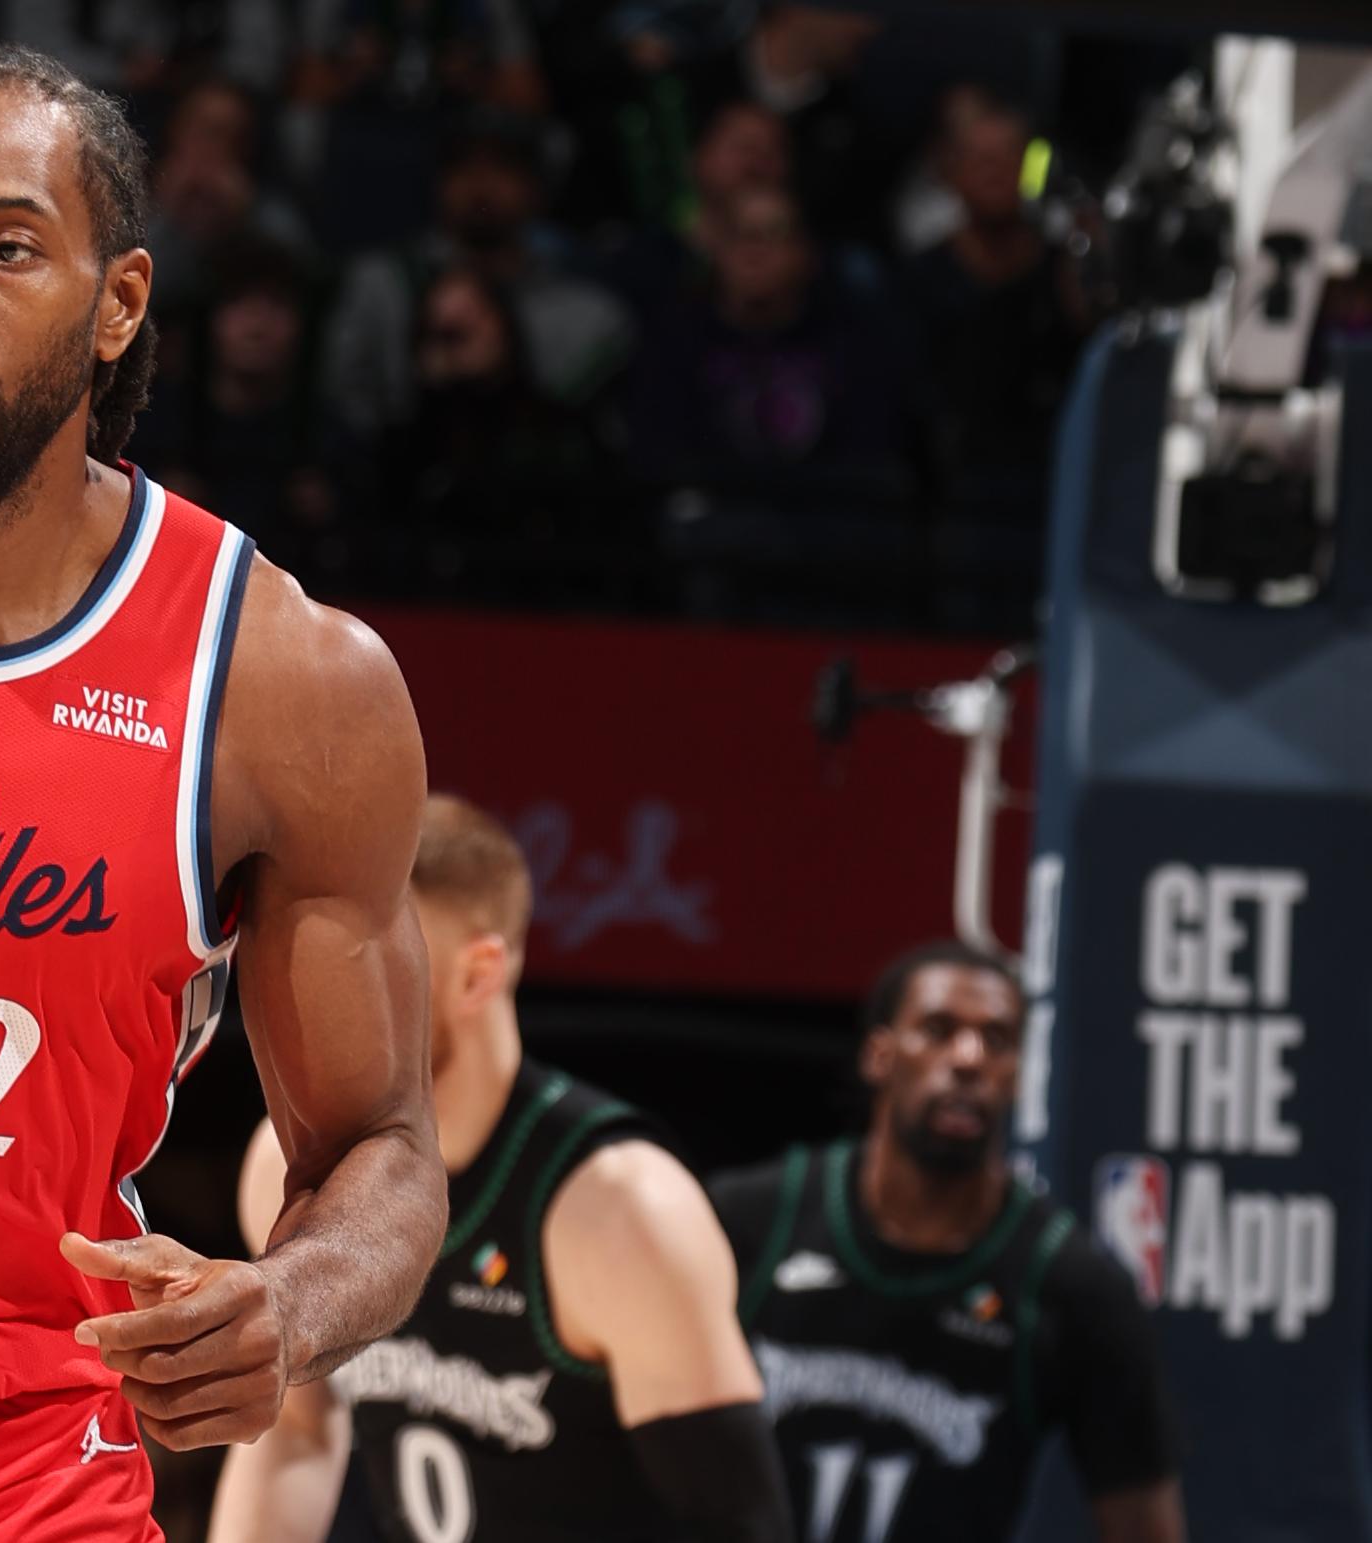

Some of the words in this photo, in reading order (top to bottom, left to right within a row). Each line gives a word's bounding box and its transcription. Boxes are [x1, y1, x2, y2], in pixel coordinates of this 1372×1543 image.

[52, 703, 168, 749] RWANDA
[82, 685, 148, 721] VISIT
[1139, 862, 1308, 1008] GET
[1137, 1013, 1305, 1155] THE
[1170, 1162, 1336, 1341] App
[396, 1425, 475, 1543] 0
[807, 1443, 916, 1543] 11
